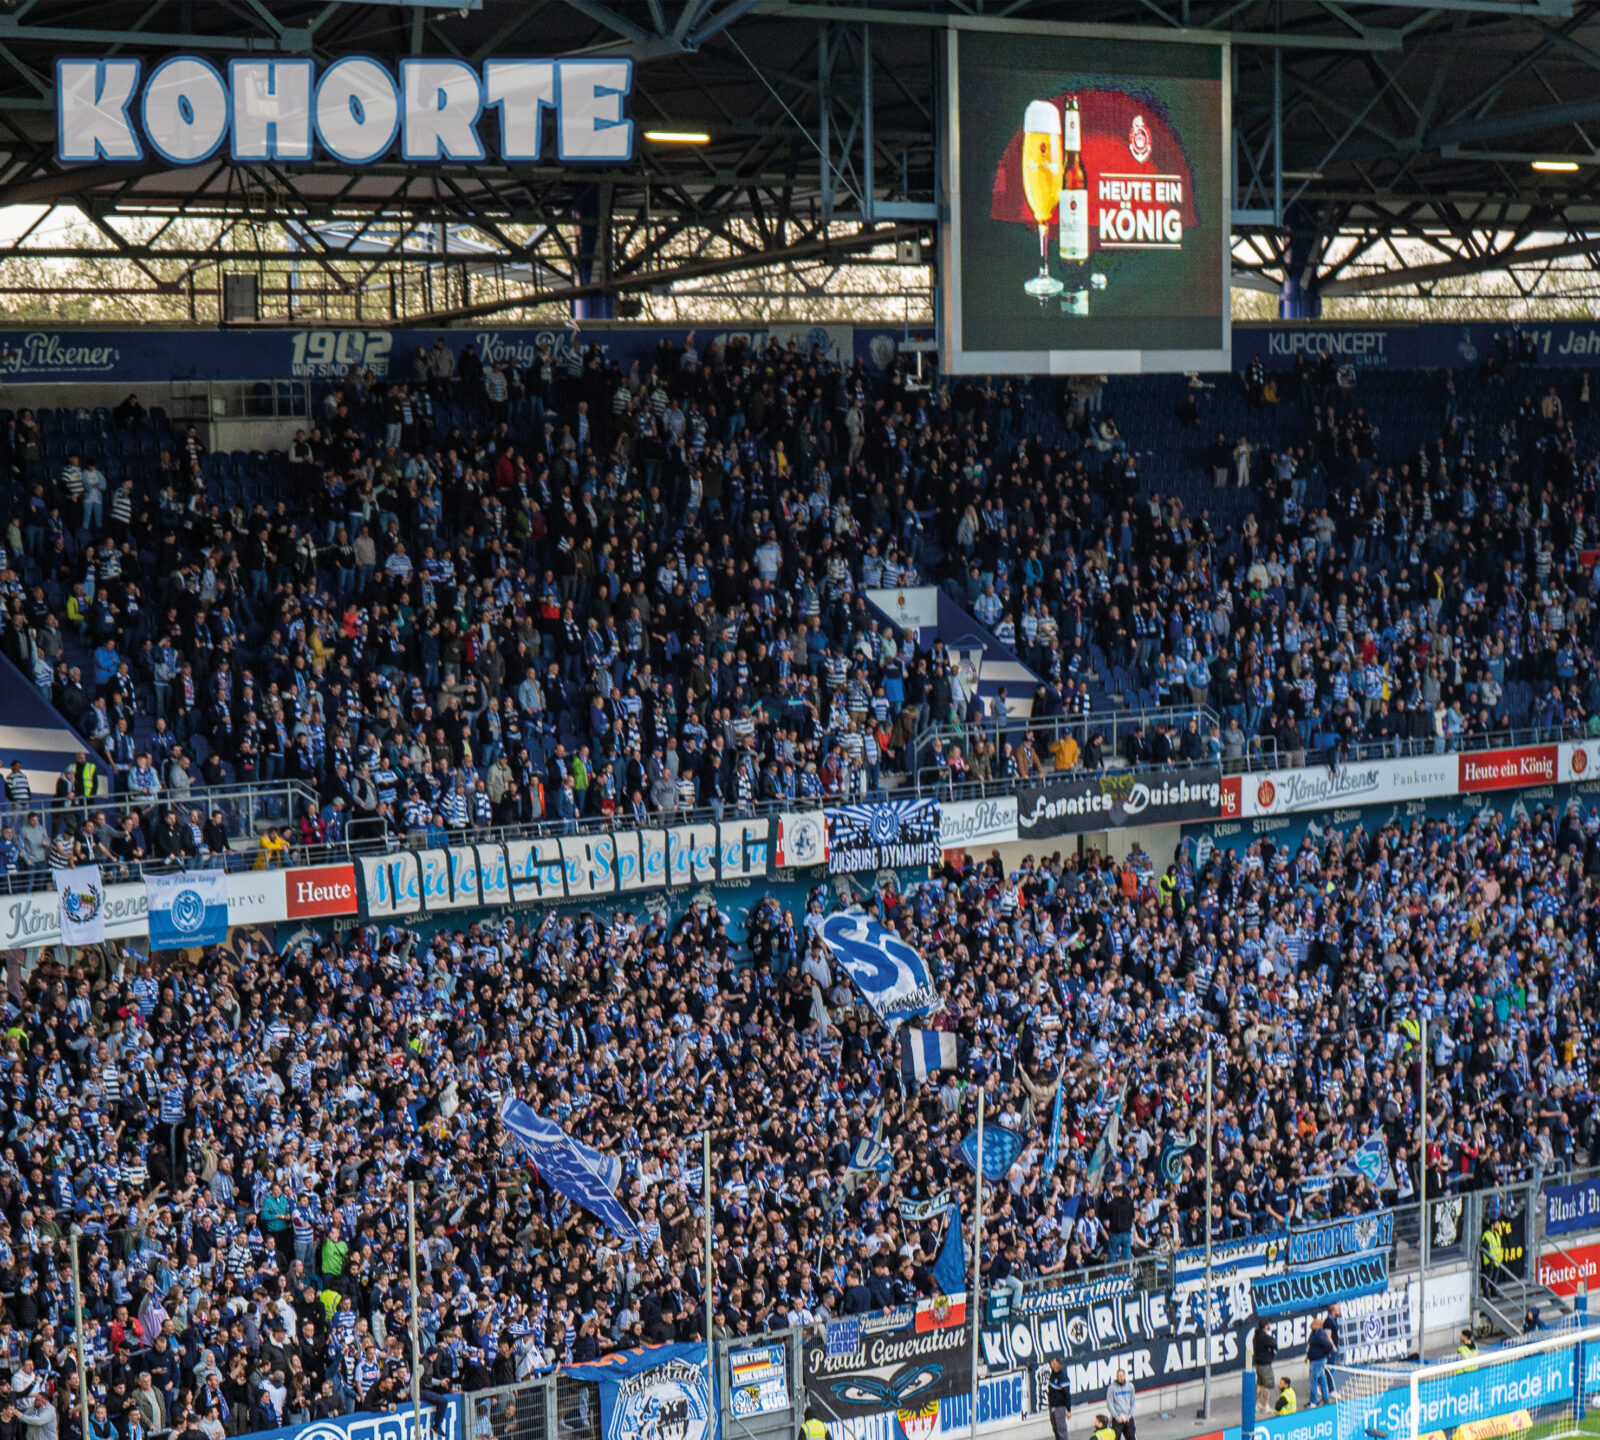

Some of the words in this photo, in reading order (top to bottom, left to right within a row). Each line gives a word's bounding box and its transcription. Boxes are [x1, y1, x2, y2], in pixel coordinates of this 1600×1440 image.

[1099, 180, 1151, 202] HEUTE
[1155, 182, 1182, 203] EIN
[1099, 201, 1182, 241] KÖNIG
[25, 332, 119, 365] Pilsener
[291, 330, 393, 364] 1902
[1269, 332, 1388, 355] KUPCONCEPT
[291, 364, 316, 377] WIR
[318, 364, 349, 377] SIND
[1465, 762, 1499, 781] Heute
[1500, 760, 1518, 778] ein
[1520, 755, 1553, 779] König
[1019, 788, 1113, 828] Fanatics
[1122, 778, 1220, 815] Duisburg
[1284, 775, 1330, 804] König
[1393, 770, 1447, 787] Fankurve
[5, 898, 61, 941] Köni
[297, 880, 351, 904] Heute
[1251, 1257, 1386, 1307] WEDAUSTADION
[1539, 1264, 1577, 1287] Heute
[1577, 1257, 1597, 1278] ein
[1411, 1292, 1465, 1314] Fnkurve
[809, 1343, 867, 1374] Proud
[870, 1327, 967, 1367] Generation
[1067, 1348, 1156, 1395] IMMER
[1163, 1331, 1238, 1374] ALLES
[1491, 1372, 1542, 1406] made
[1546, 1367, 1562, 1392] in
